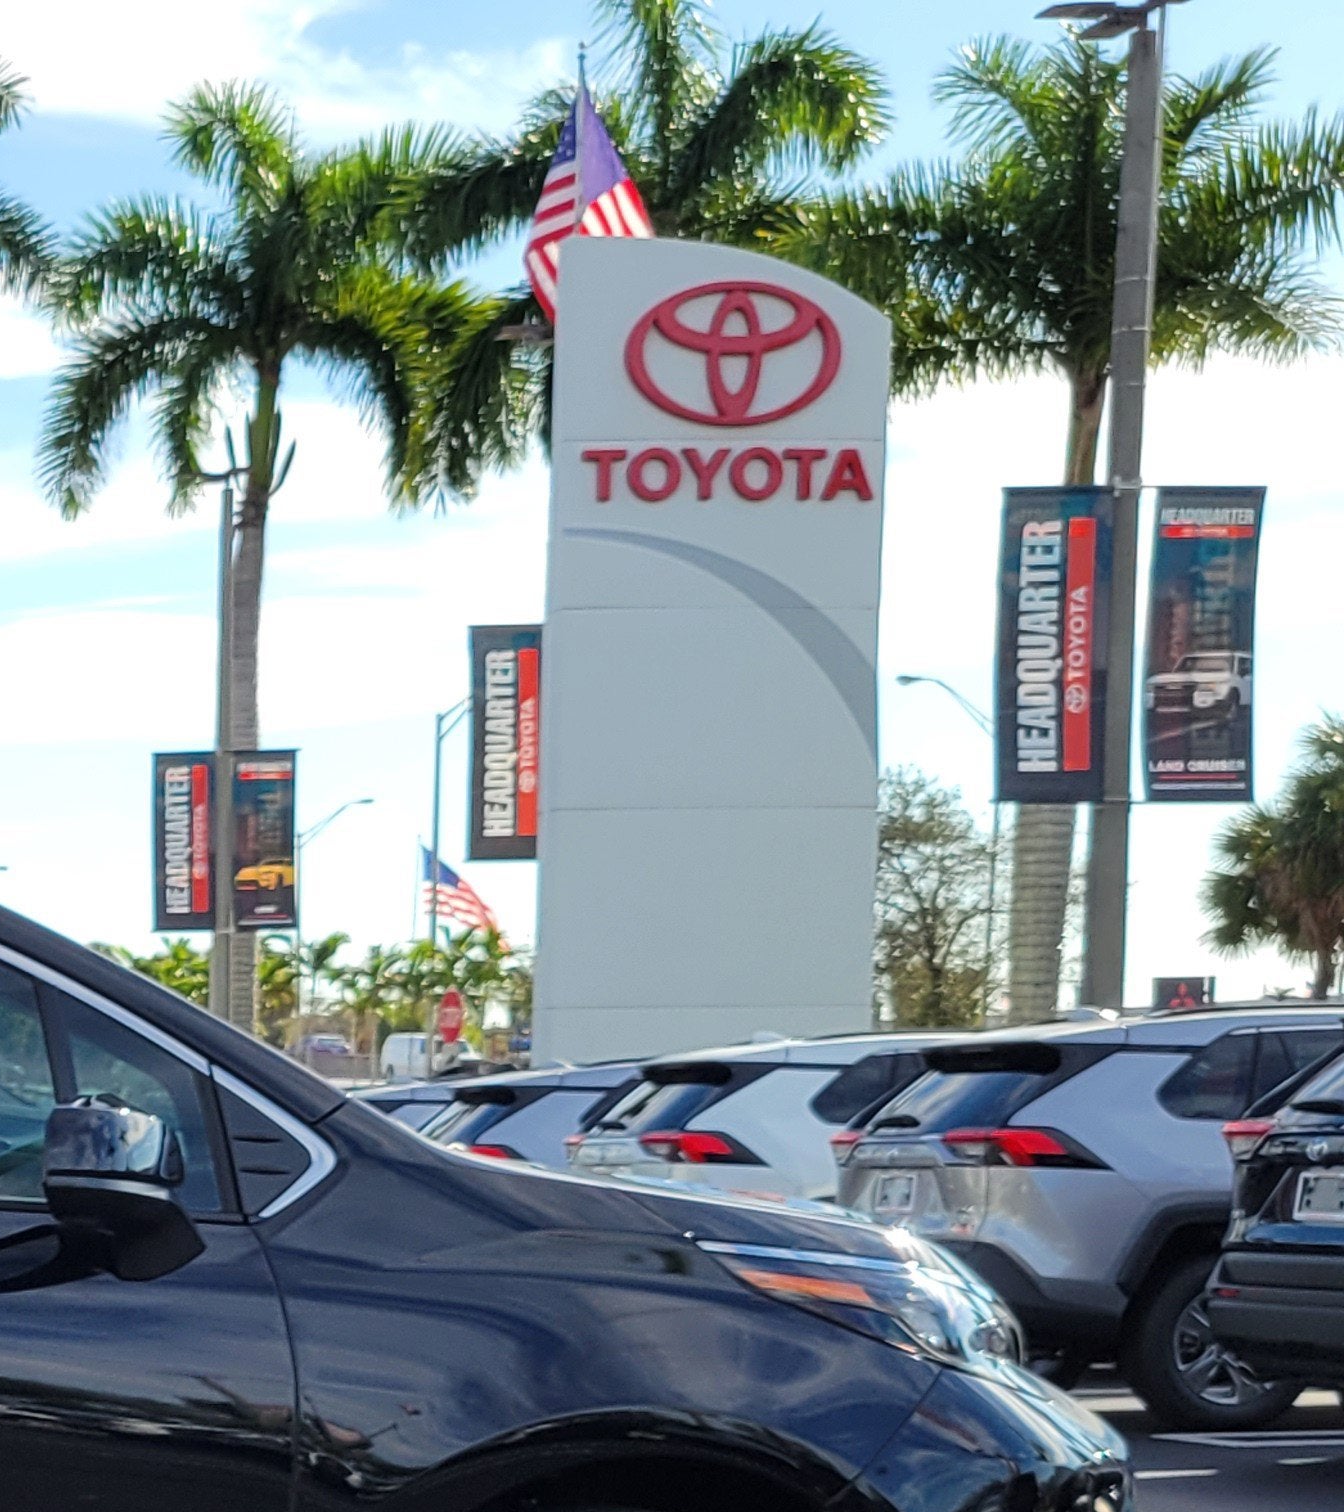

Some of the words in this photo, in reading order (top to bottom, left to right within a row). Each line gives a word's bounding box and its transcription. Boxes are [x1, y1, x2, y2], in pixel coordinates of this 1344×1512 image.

[581, 446, 874, 502] TOYOTA
[1016, 520, 1063, 772] HEADQUARTER
[1068, 586, 1089, 681] TOYOTA
[482, 649, 517, 837] HEADQUARTER
[520, 697, 536, 768] TOYOTA
[165, 765, 192, 914] HEADQUARTER
